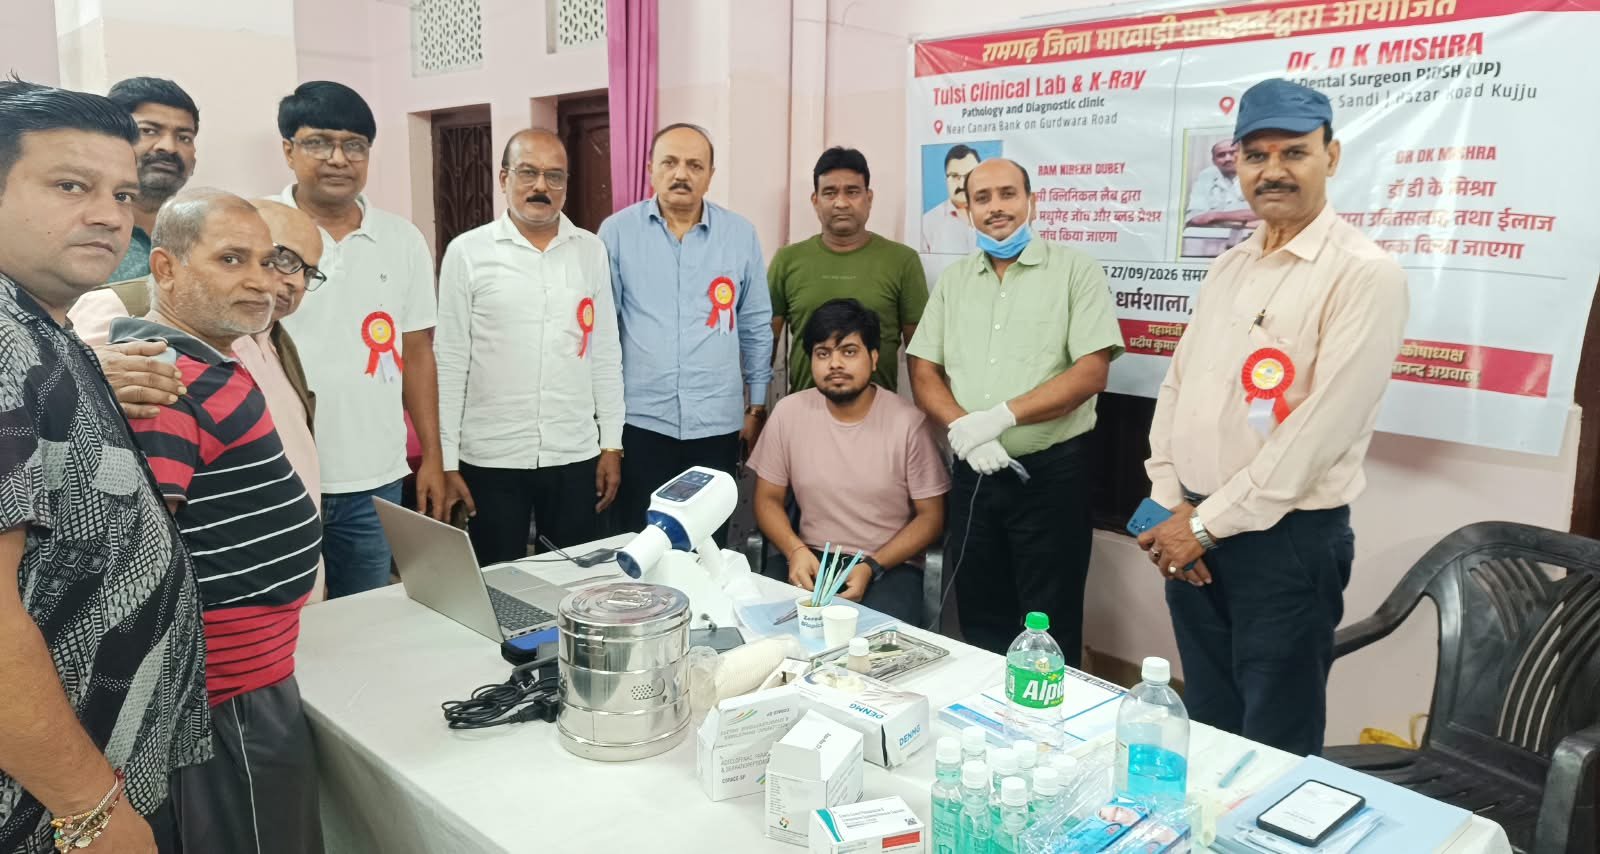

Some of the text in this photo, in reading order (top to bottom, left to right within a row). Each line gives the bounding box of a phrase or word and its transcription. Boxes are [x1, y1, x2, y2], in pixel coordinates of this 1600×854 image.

[983, 37, 1040, 63] रामगढ़
[1042, 28, 1092, 57] जिला
[1287, 32, 1484, 72] Dr. D K MISHRA
[1350, 70, 1411, 88] Surgeon
[1466, 61, 1502, 80] (UP)
[933, 70, 1147, 105] Tulsi Clinical Lab & X-Ray
[1338, 89, 1379, 109] Sandi
[1491, 82, 1538, 102] Kujju
[962, 96, 1105, 118] Pathology and Diagnostic clinic
[946, 112, 1118, 135] Near Canara Bank on Gurdwara Road
[1417, 148, 1434, 163] DK
[1438, 145, 1498, 162] MHRA
[1038, 164, 1057, 176] RAM
[1095, 162, 1126, 175] DUBEY
[1049, 187, 1098, 202] क्लिनिकल
[1100, 186, 1119, 202] लैब
[1120, 189, 1142, 204] द्वारा
[1407, 177, 1425, 198] डी
[1427, 177, 1443, 197] के
[1454, 209, 1494, 228] तथा
[1497, 207, 1557, 232] ईलाज
[1059, 227, 1084, 241] किया
[1085, 231, 1118, 242] जाएगा
[1463, 238, 1525, 260] जाएगा
[1110, 265, 1178, 281] 27/09/2026
[1116, 287, 1193, 315] धर्मशाला,
[899, 724, 921, 746] DENMG
